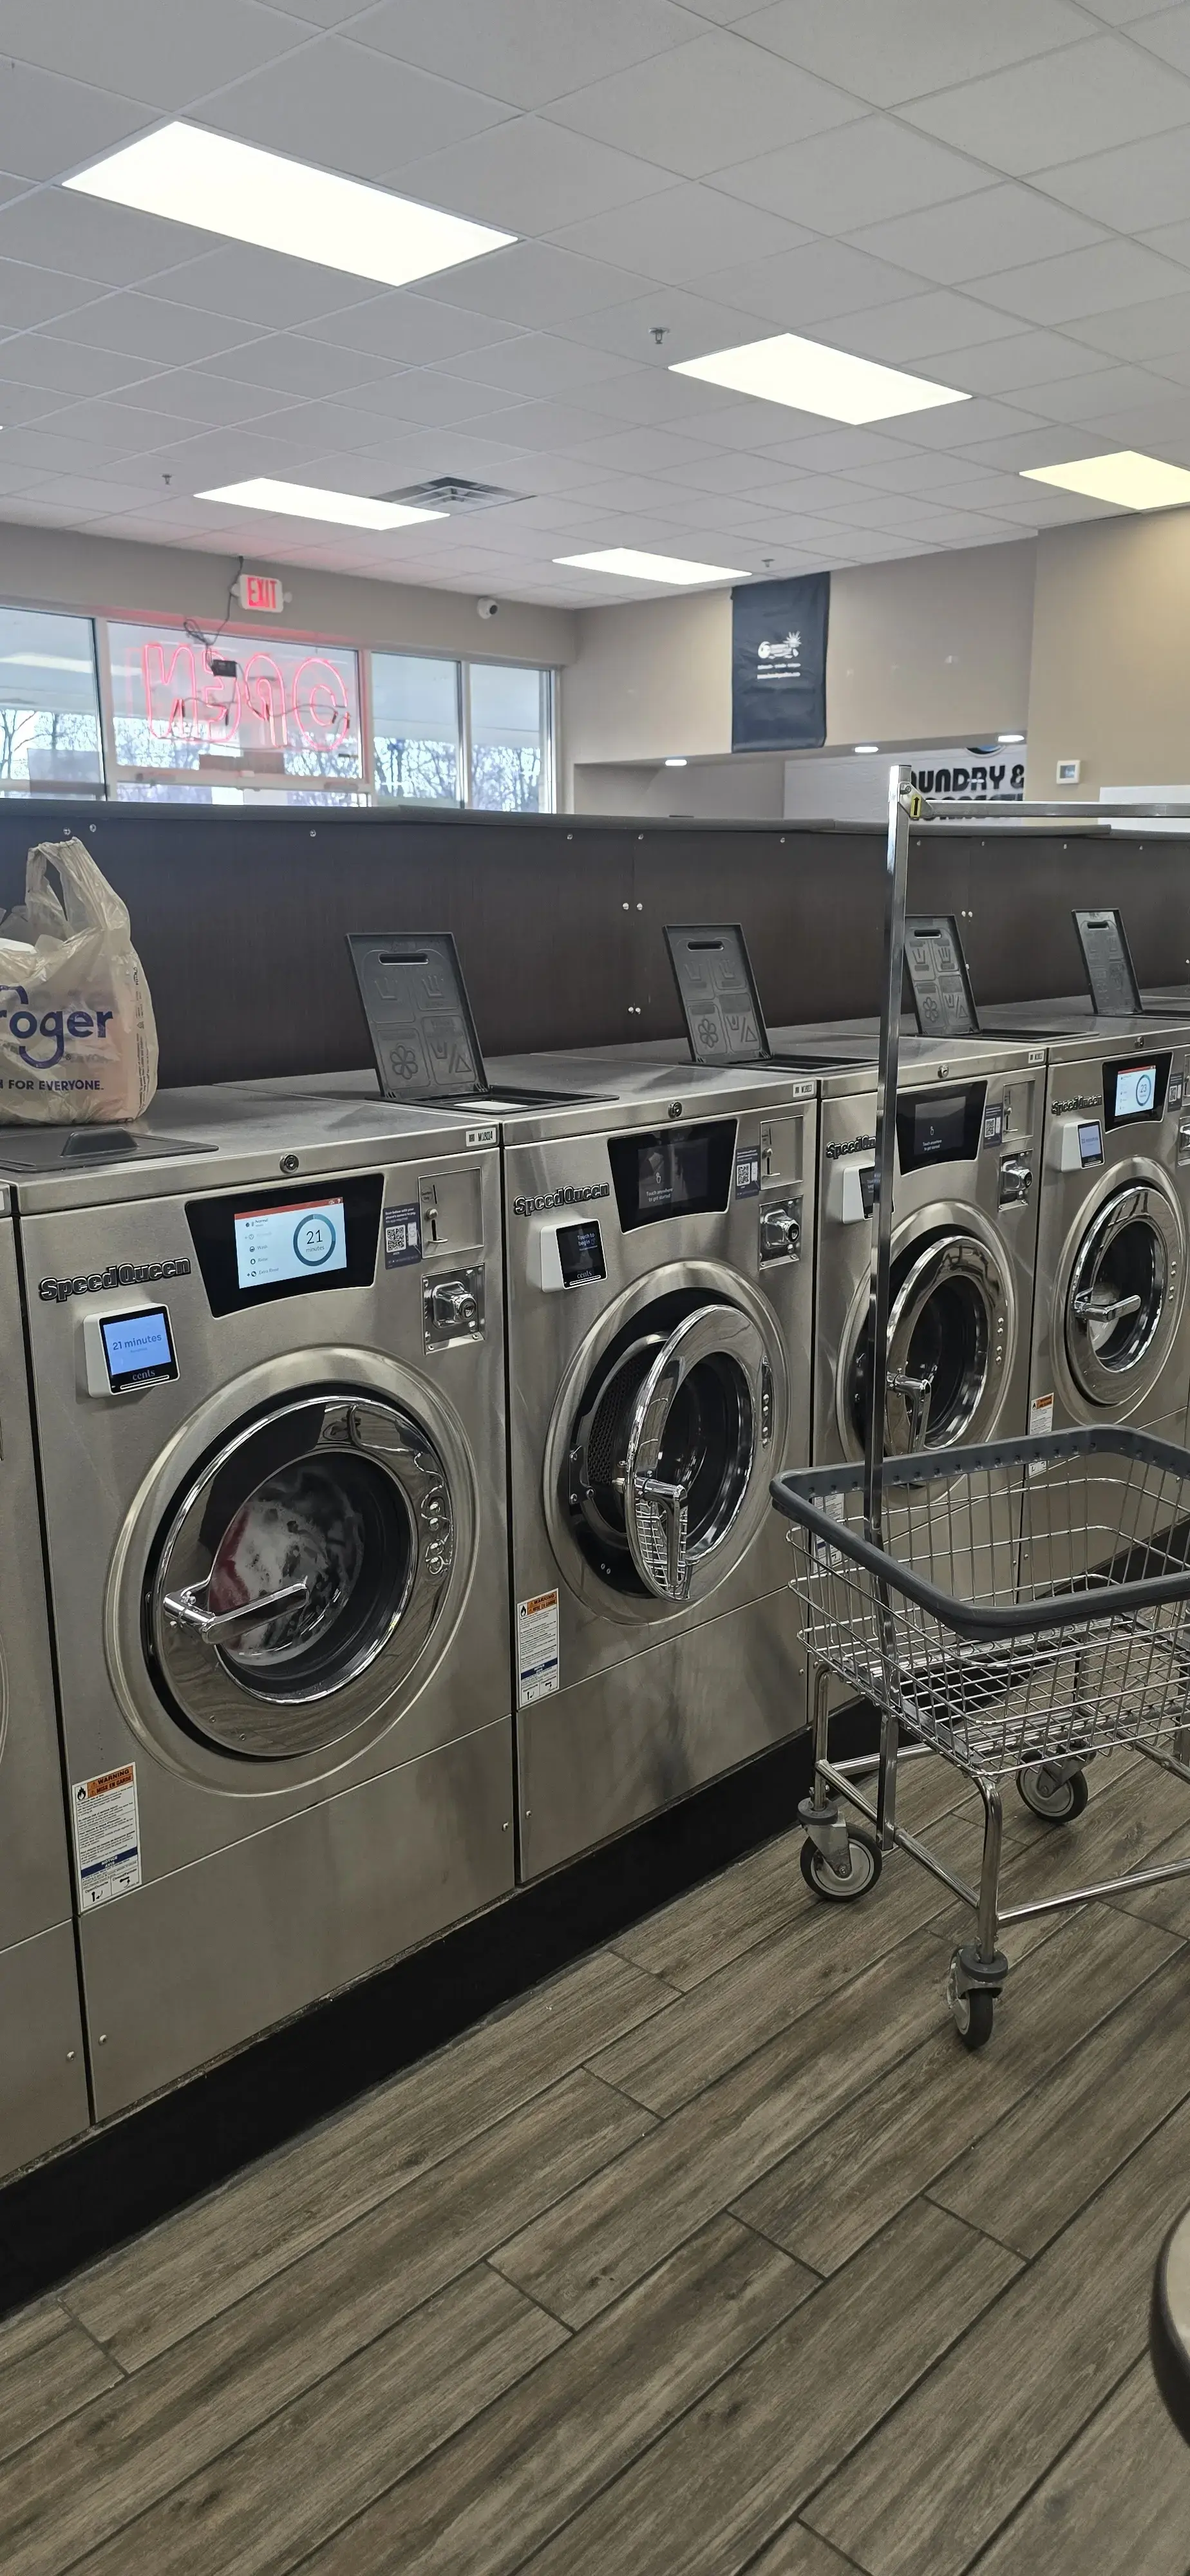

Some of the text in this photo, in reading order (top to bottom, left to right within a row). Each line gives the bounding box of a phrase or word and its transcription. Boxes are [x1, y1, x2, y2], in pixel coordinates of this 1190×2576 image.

[247, 577, 278, 609] EXIT
[911, 764, 1024, 793] UNDRY &
[0, 985, 113, 1069] oger
[8, 1080, 34, 1090] FOR
[1140, 1084, 1147, 1093] 23
[307, 1229, 323, 1244] 21
[577, 1270, 592, 1279] cents
[113, 1341, 122, 1350] 21
[124, 1334, 162, 1348] minutes
[132, 1369, 155, 1381] cents
[97, 1769, 129, 1785] WARNING
[97, 1785, 108, 1794] MISE
[117, 1776, 131, 1786] GARDE
[101, 1855, 118, 1865] NOTICE
